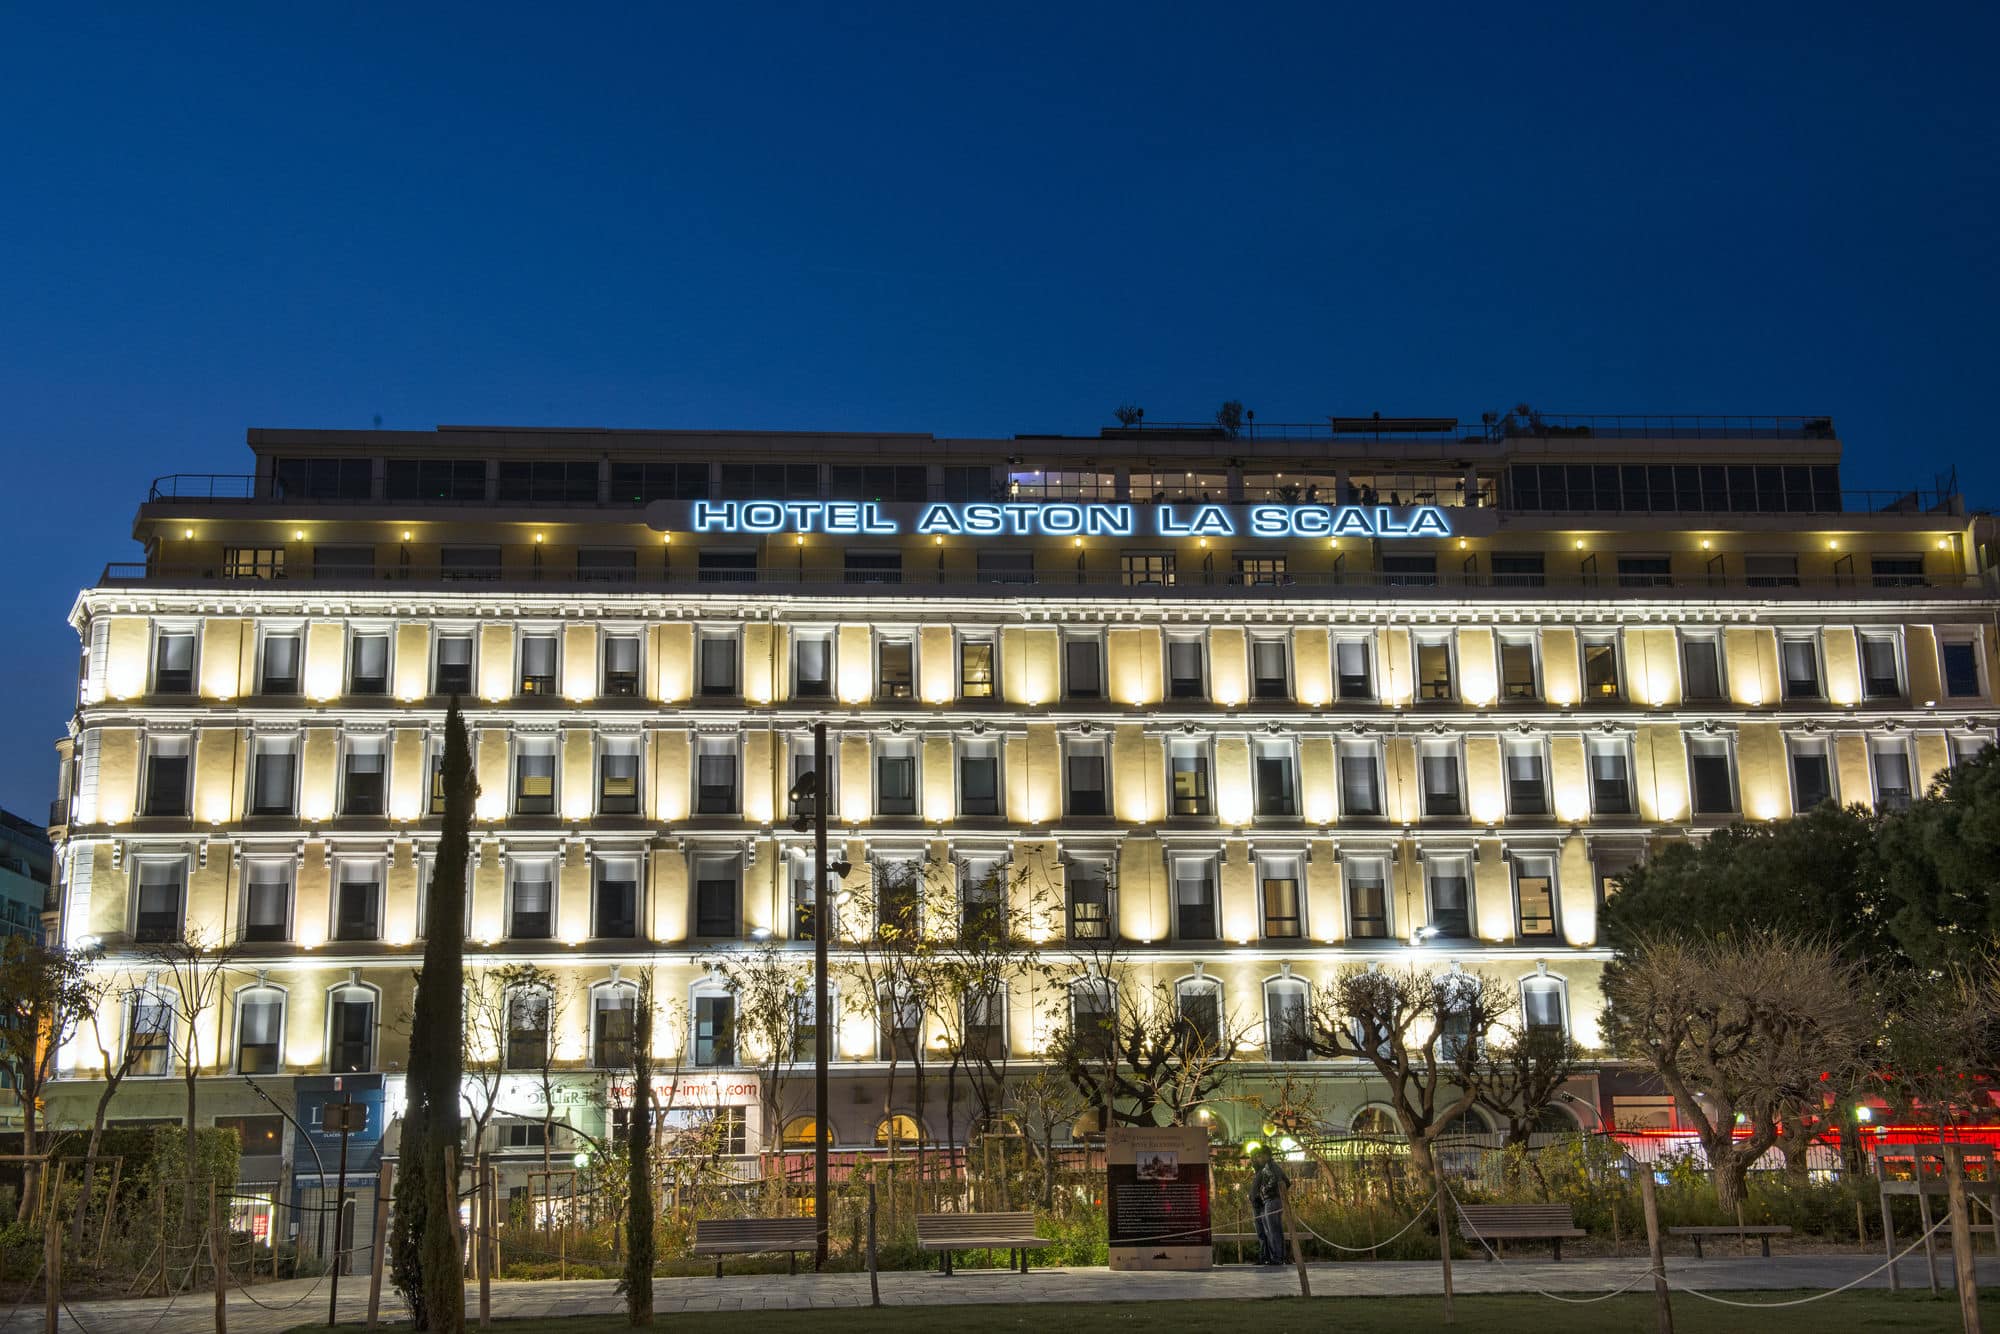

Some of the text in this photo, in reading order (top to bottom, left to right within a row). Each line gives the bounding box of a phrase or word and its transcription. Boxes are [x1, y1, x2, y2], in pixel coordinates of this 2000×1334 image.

[695, 501, 1450, 537] HOTEL ASTON LA SCALA
